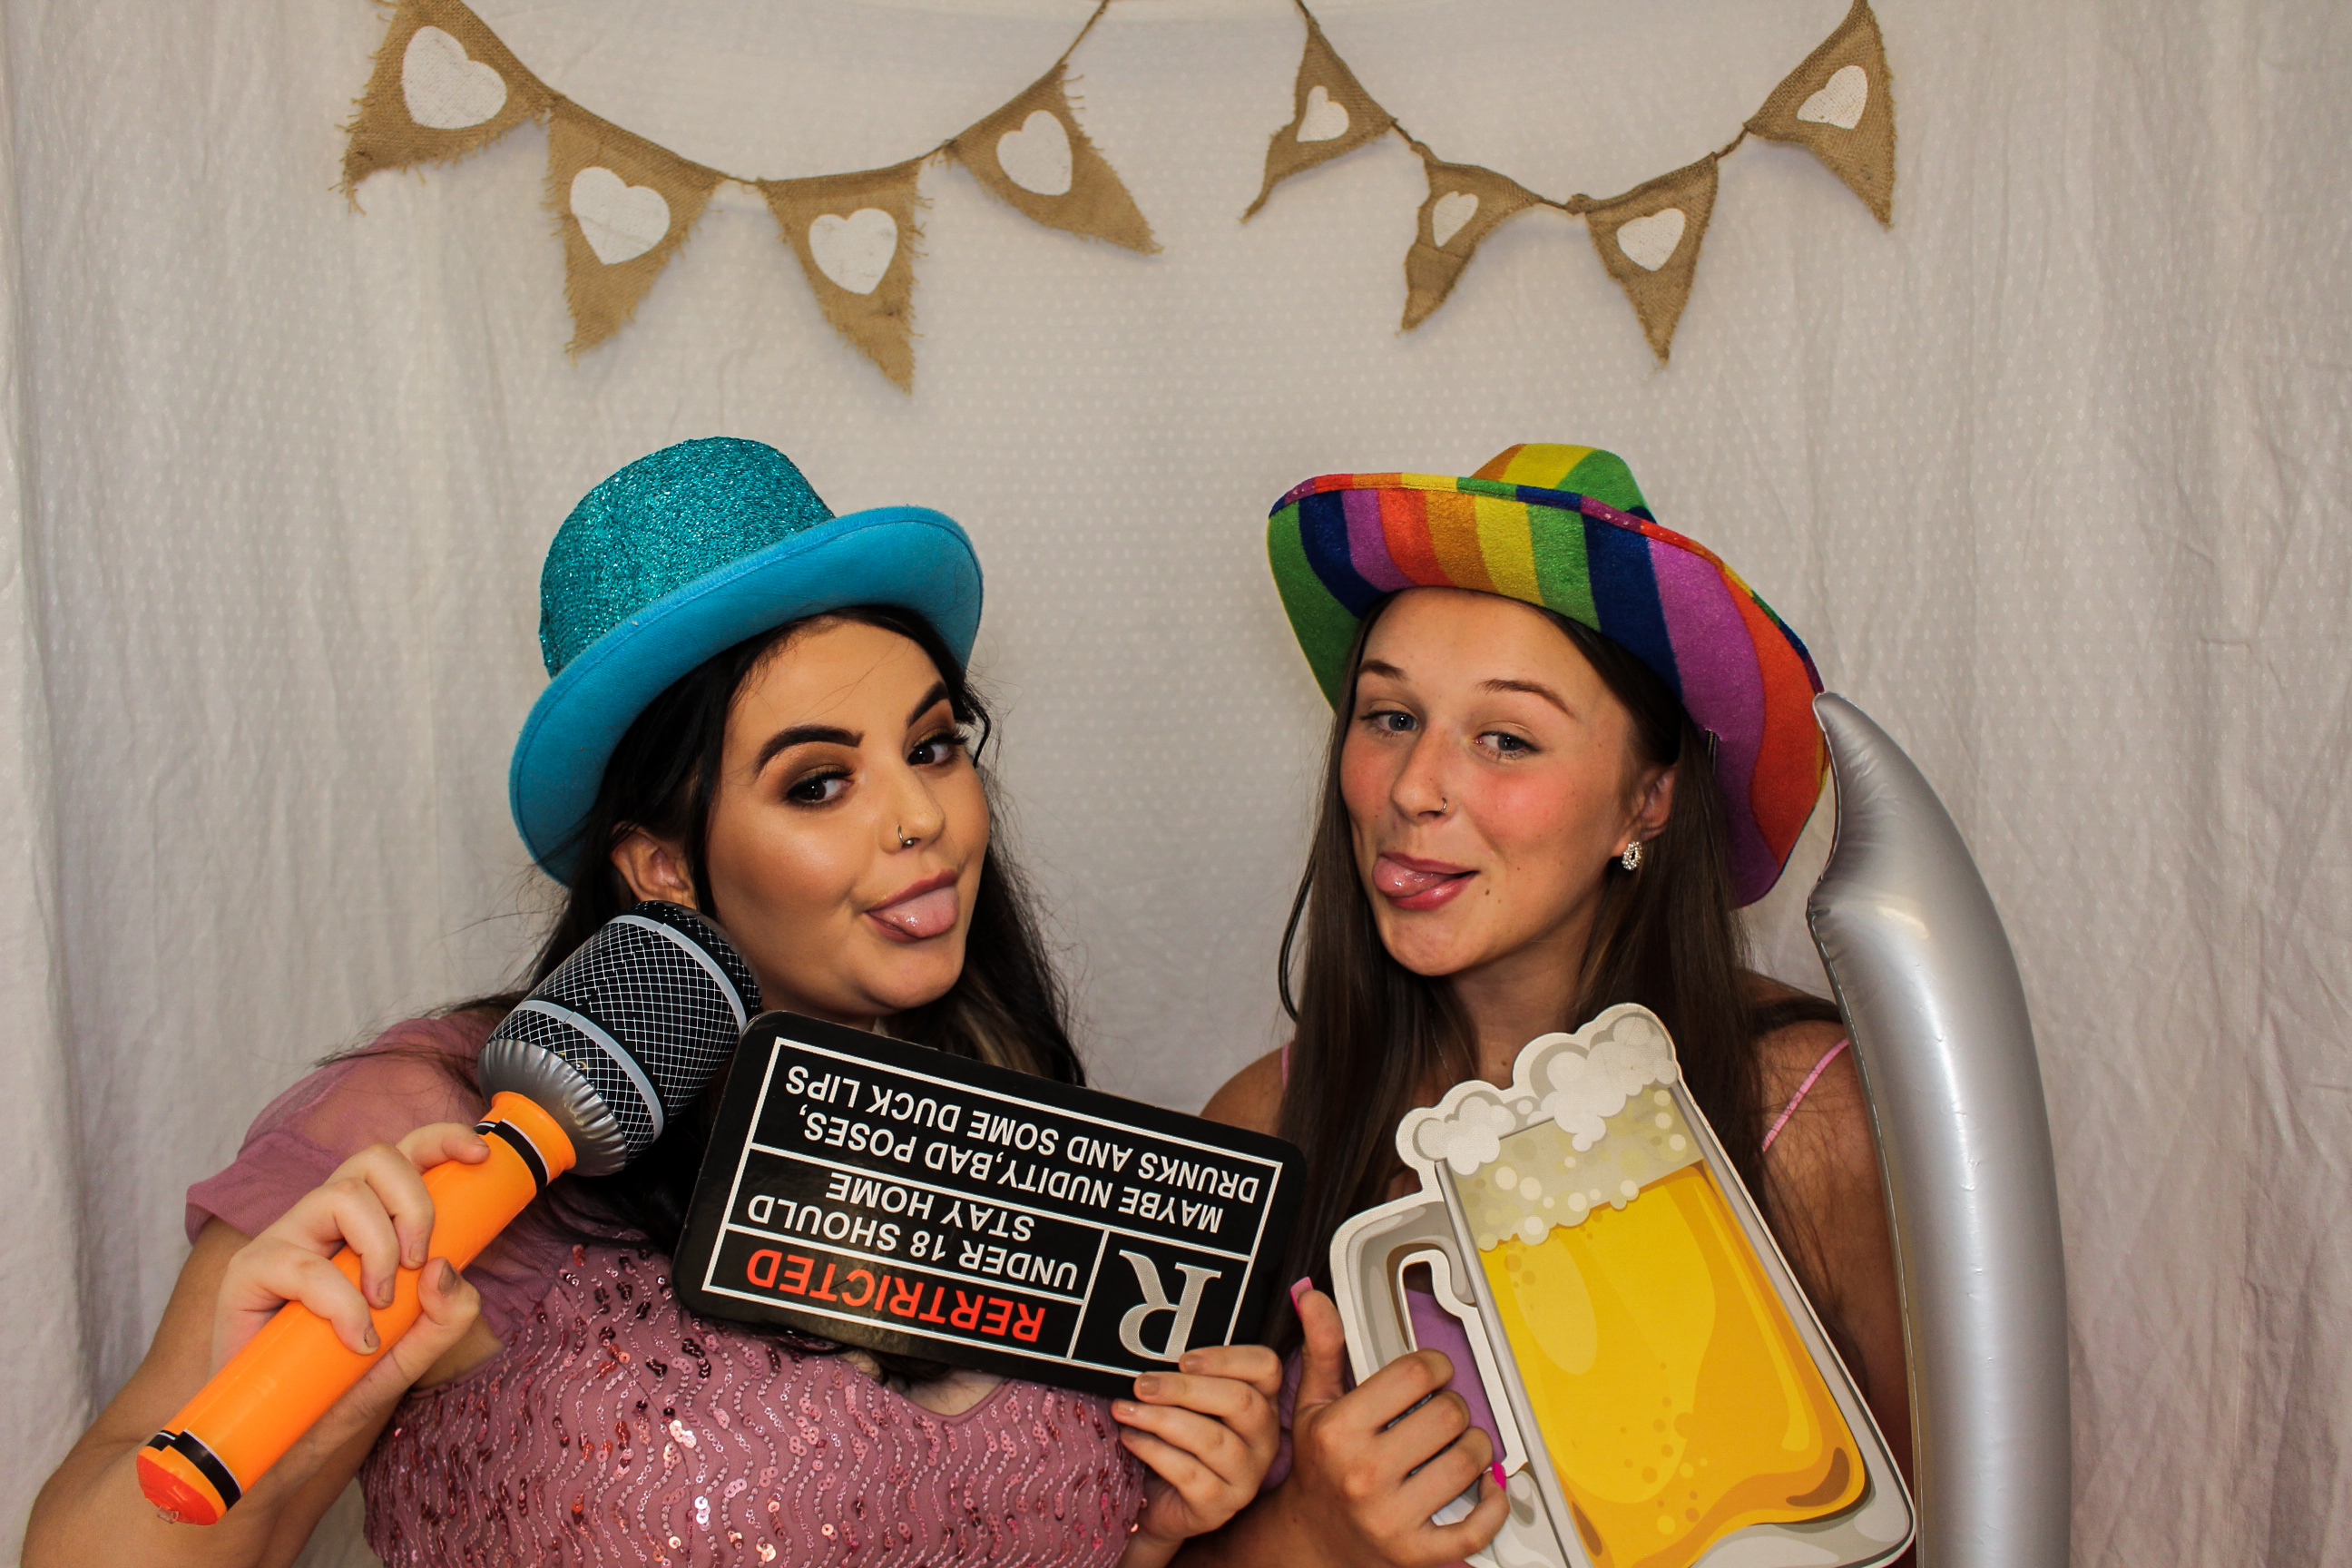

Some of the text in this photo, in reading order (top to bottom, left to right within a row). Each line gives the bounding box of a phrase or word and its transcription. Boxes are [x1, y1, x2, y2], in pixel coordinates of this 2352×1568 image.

[785, 1065, 1259, 1204] DRUNKS AND SOME DUCK LIPS
[799, 1103, 917, 1163] POSES,
[748, 1194, 1078, 1290] UNDER 18 SHOULD
[825, 1171, 1034, 1242] STAY HOME
[1117, 1186, 1224, 1234] MAYBE
[746, 1249, 1046, 1343] RERTRICTED
[1119, 1249, 1222, 1363] R
